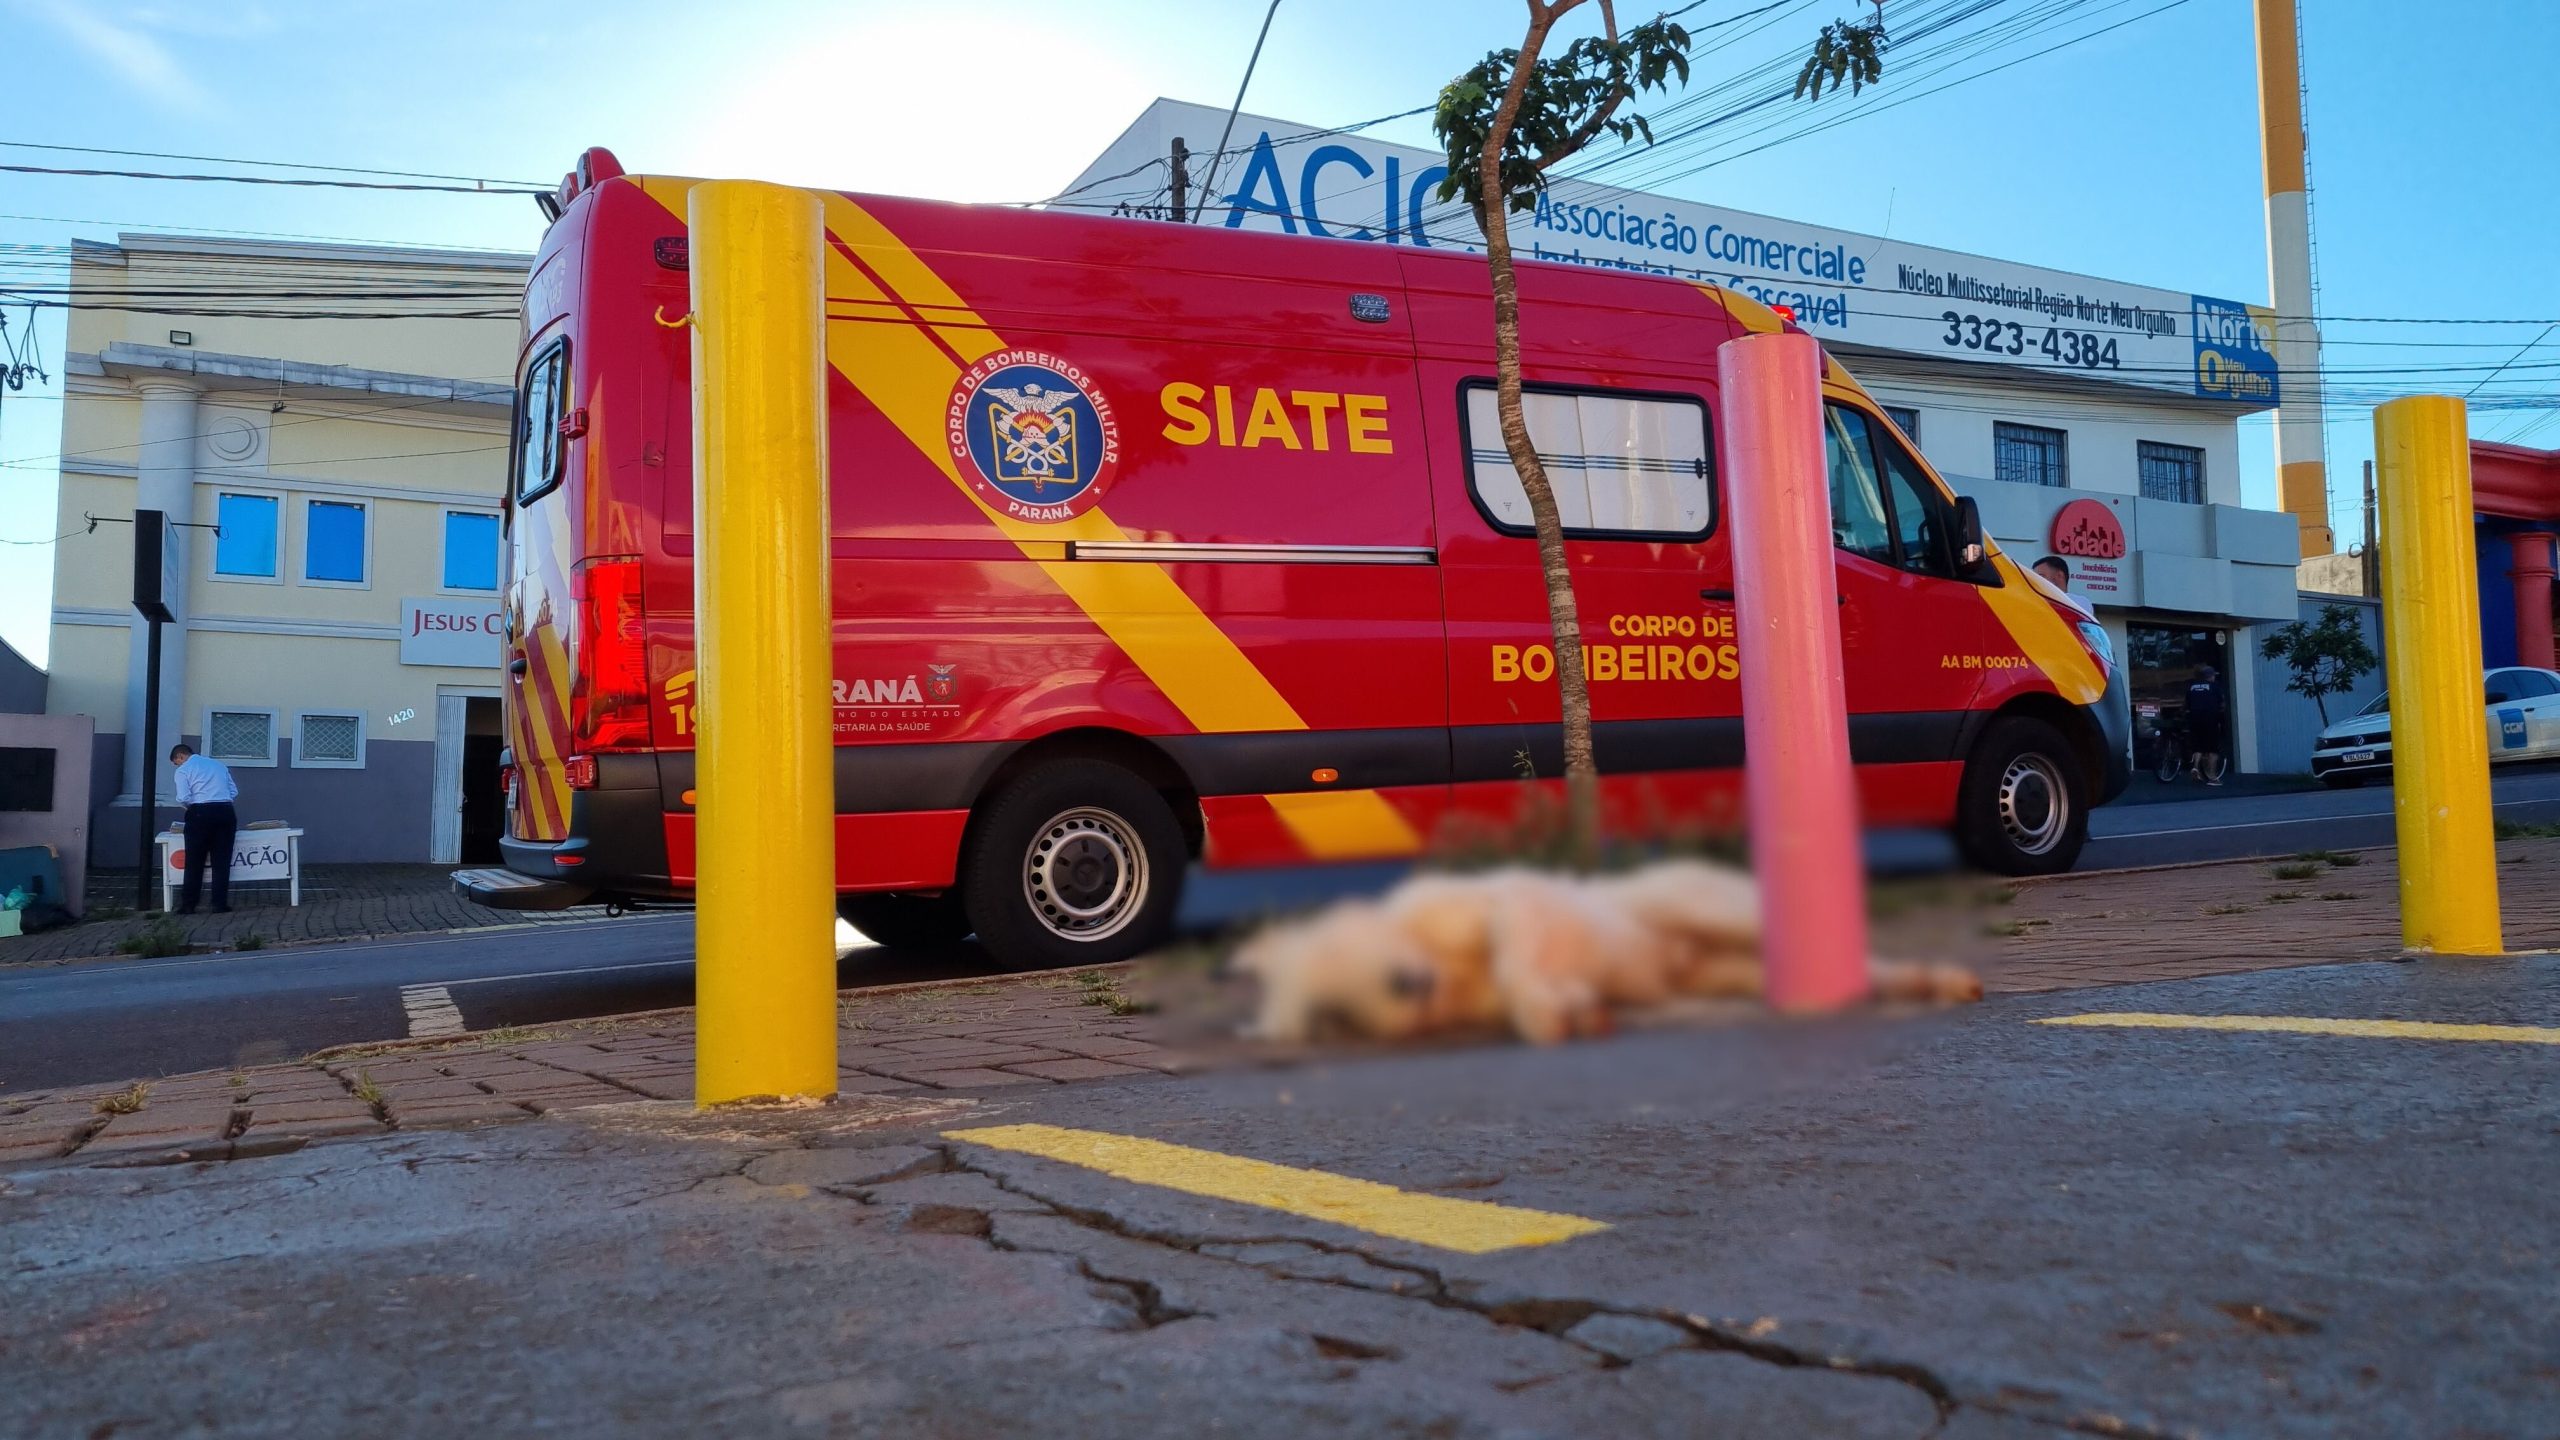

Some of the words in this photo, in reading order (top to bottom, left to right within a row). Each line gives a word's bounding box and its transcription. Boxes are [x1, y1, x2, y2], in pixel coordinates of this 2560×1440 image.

[1533, 191, 1697, 255] Associação
[1705, 224, 1844, 282] Comercial
[1898, 263, 1943, 295] Núcleo
[1947, 272, 2032, 311] Multissetorial
[2035, 287, 2074, 322] Região
[2076, 294, 2108, 325] Norte
[2111, 301, 2133, 328] Meu
[2135, 305, 2176, 339] Orgulho
[1942, 310, 2120, 369] 3323-4384
[2197, 302, 2272, 353] Norte
[2199, 349, 2272, 399] Orgulho
[2224, 357, 2245, 371] Meu
[950, 392, 967, 458] CORPO
[962, 366, 985, 390] DE
[984, 350, 1090, 389] BOMBEIROS
[1089, 390, 1118, 464] MILITAR
[1160, 381, 1394, 454] SIATE
[1008, 501, 1074, 520] PARANÁ
[2055, 531, 2125, 558] cidade
[412, 609, 477, 637] JESUS
[1609, 614, 1696, 637] CORPO
[1702, 616, 1735, 637] DE
[1492, 644, 1740, 682] BOBEIROS
[1941, 655, 1960, 669] AA
[1963, 656, 1981, 669] BM
[1985, 656, 2029, 669] 00074
[832, 675, 923, 703] RANÁ
[387, 708, 415, 726] 1420
[832, 723, 876, 732] RETARIA
[880, 723, 893, 731] DA
[897, 722, 931, 732] SAÚDE
[901, 710, 960, 718] ESTADO
[230, 845, 288, 869] AÇÃO
